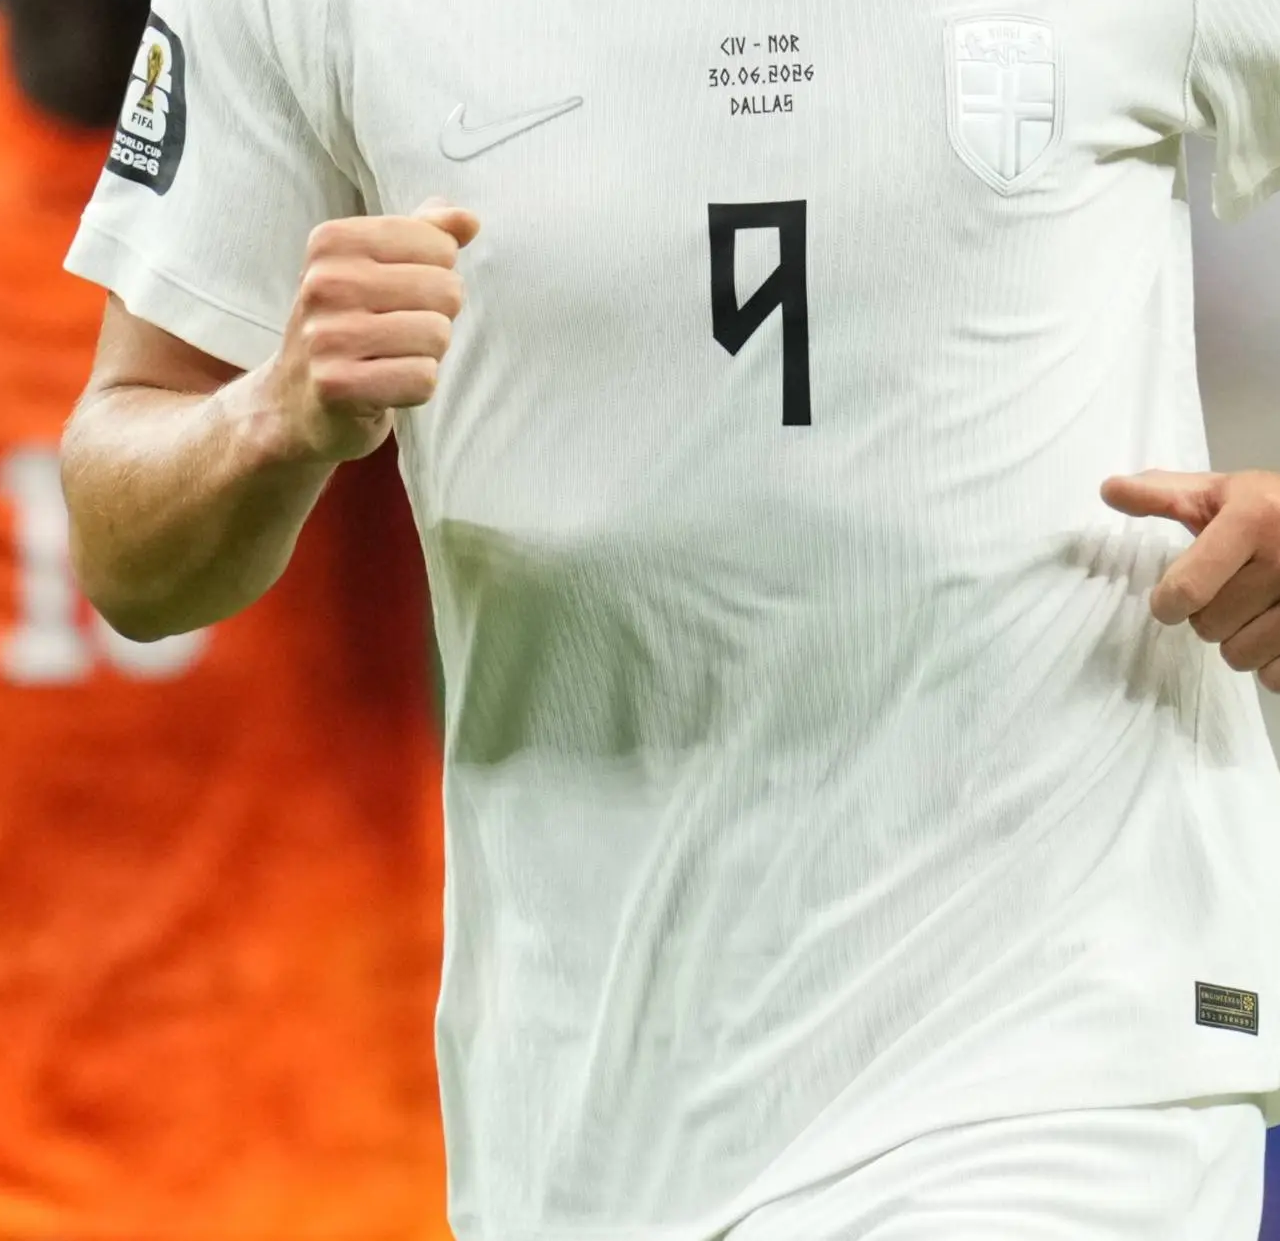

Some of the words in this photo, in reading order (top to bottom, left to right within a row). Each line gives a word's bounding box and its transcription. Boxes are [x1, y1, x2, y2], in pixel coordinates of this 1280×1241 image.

[720, 36, 746, 56] CIV
[768, 34, 800, 53] NOR
[708, 64, 814, 87] 30.06.2026
[730, 94, 793, 115] DALLAS
[131, 112, 153, 130] FIFA
[110, 142, 159, 176] 2026
[144, 144, 162, 159] CUP
[708, 199, 811, 426] 9
